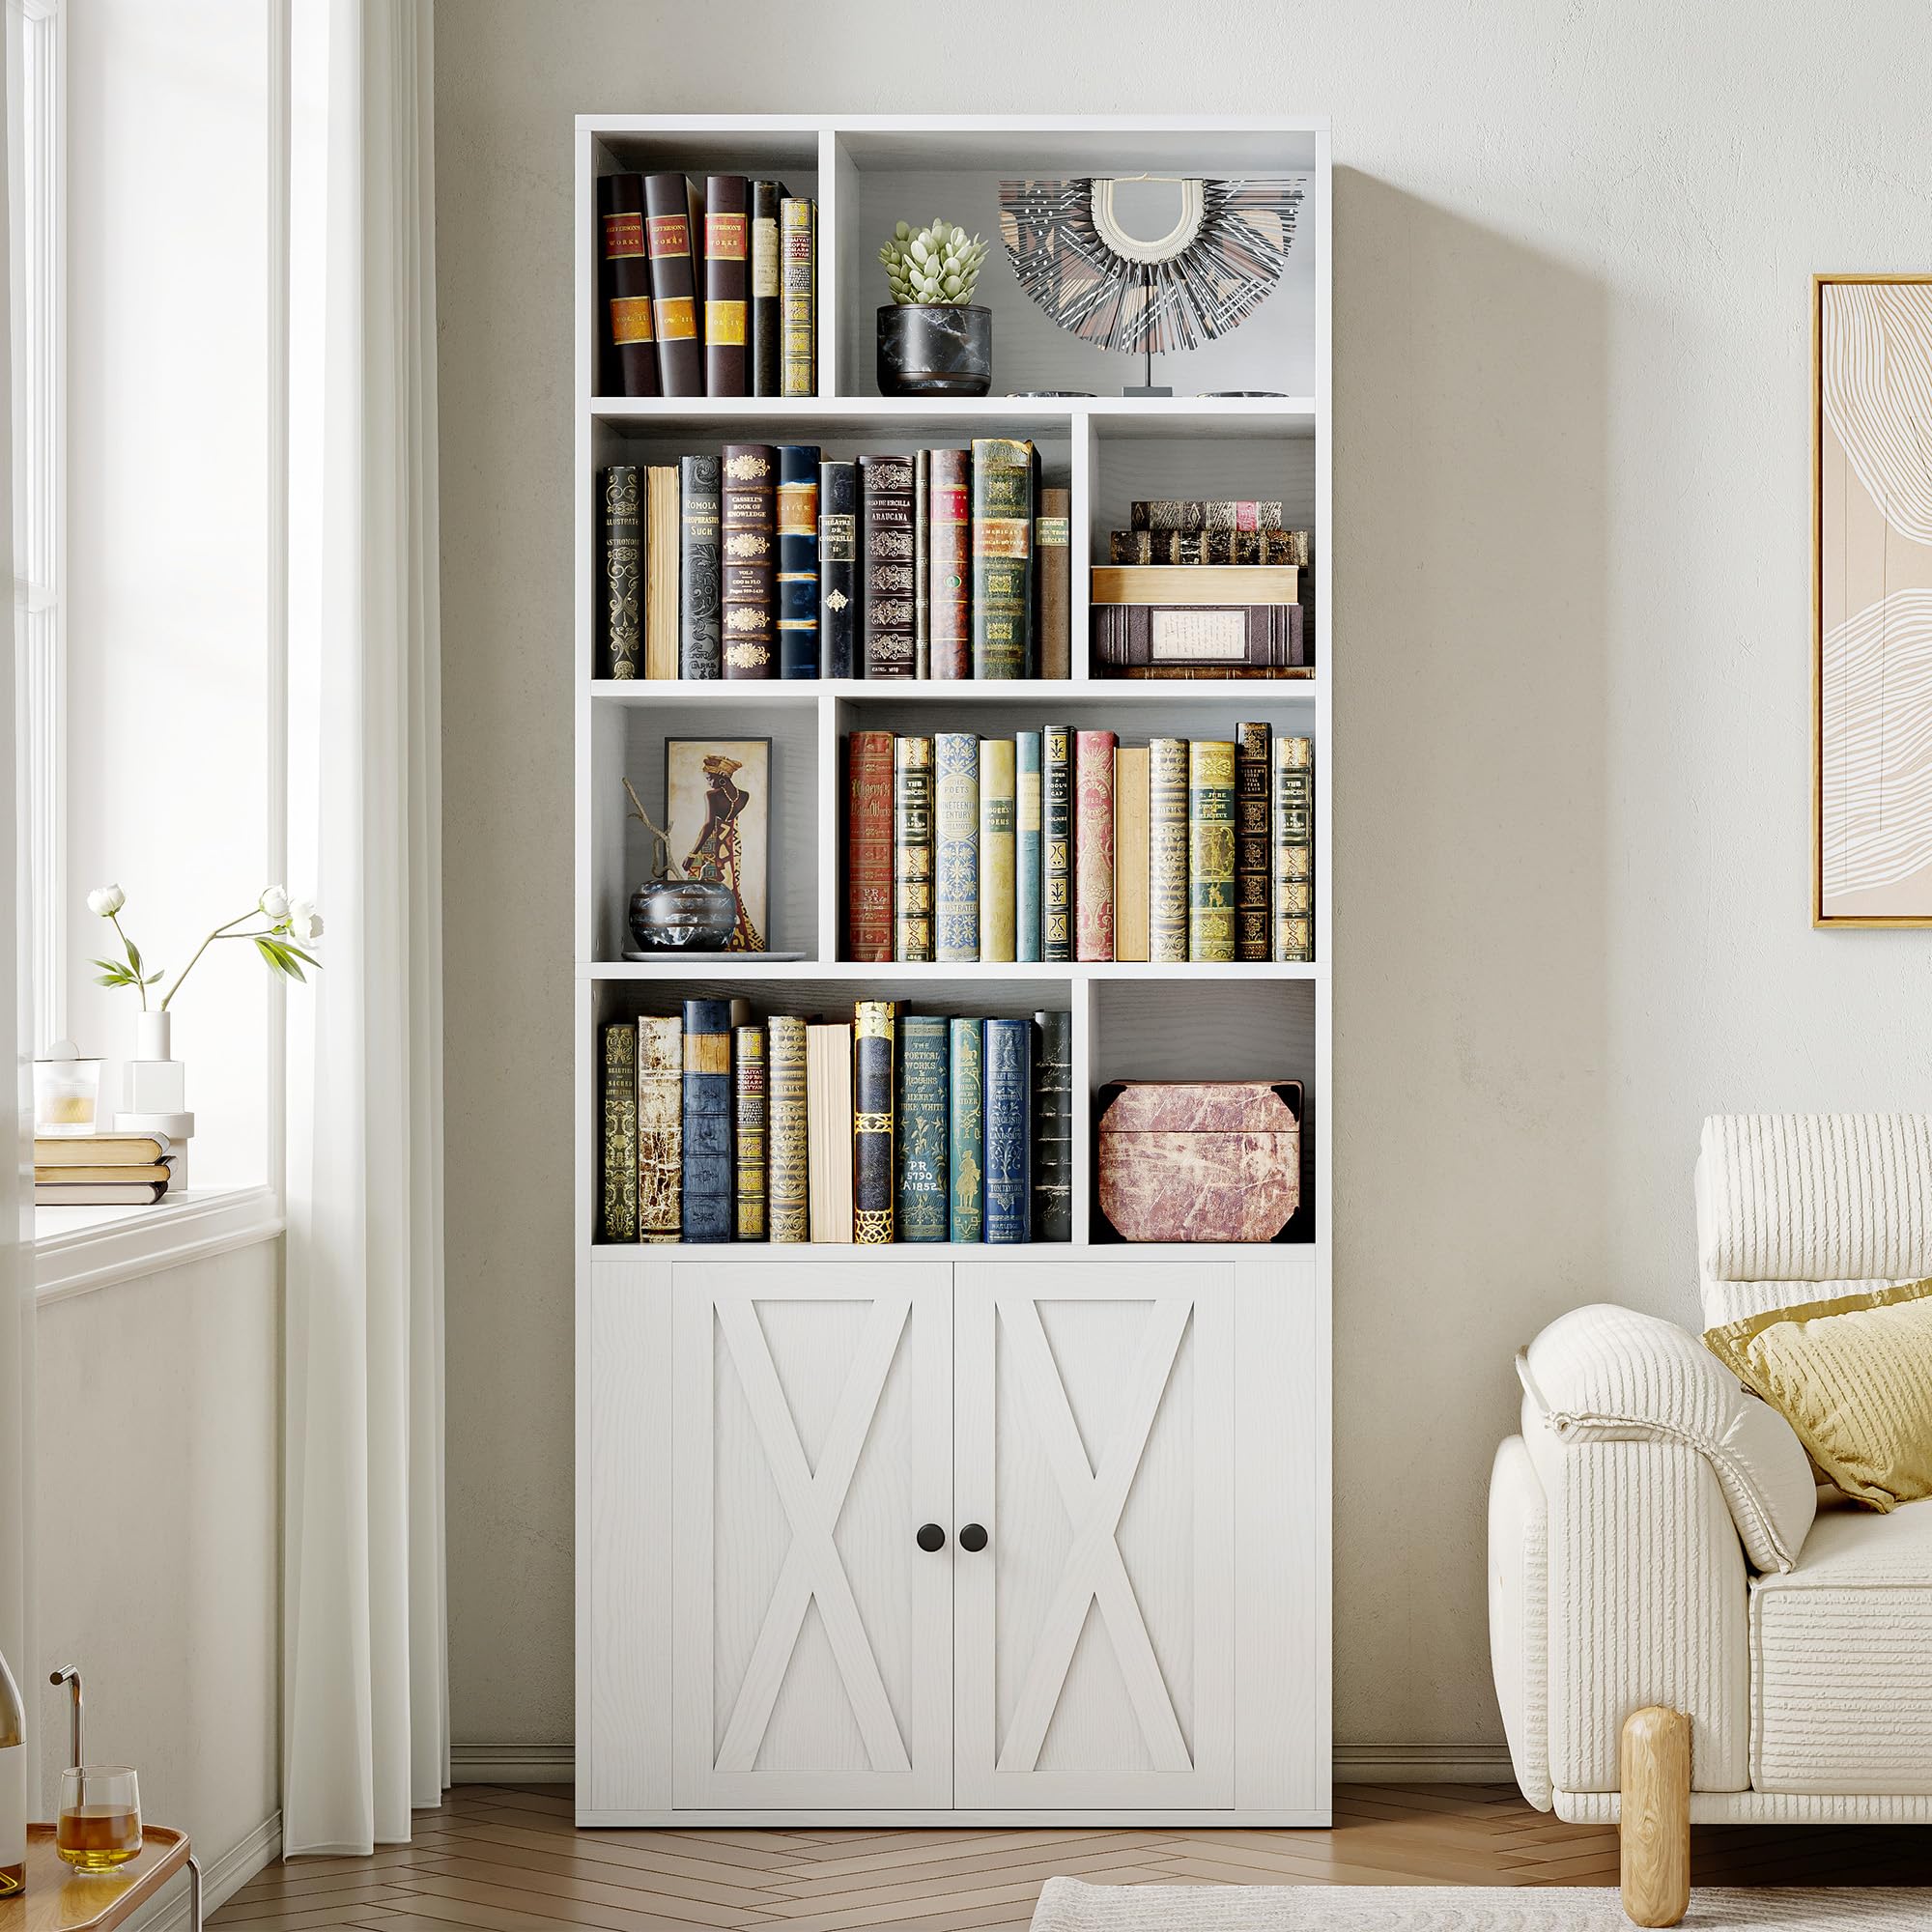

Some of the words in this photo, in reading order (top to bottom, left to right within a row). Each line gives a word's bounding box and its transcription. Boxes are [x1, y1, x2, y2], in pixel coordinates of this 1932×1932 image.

[871, 512, 908, 522] ARAUCANA
[944, 785, 970, 794] POETS
[904, 1051, 940, 1060] POETICAL
[907, 1093, 934, 1101] HENRY
[908, 1161, 927, 1172] PR
[907, 1172, 933, 1180] 5790
